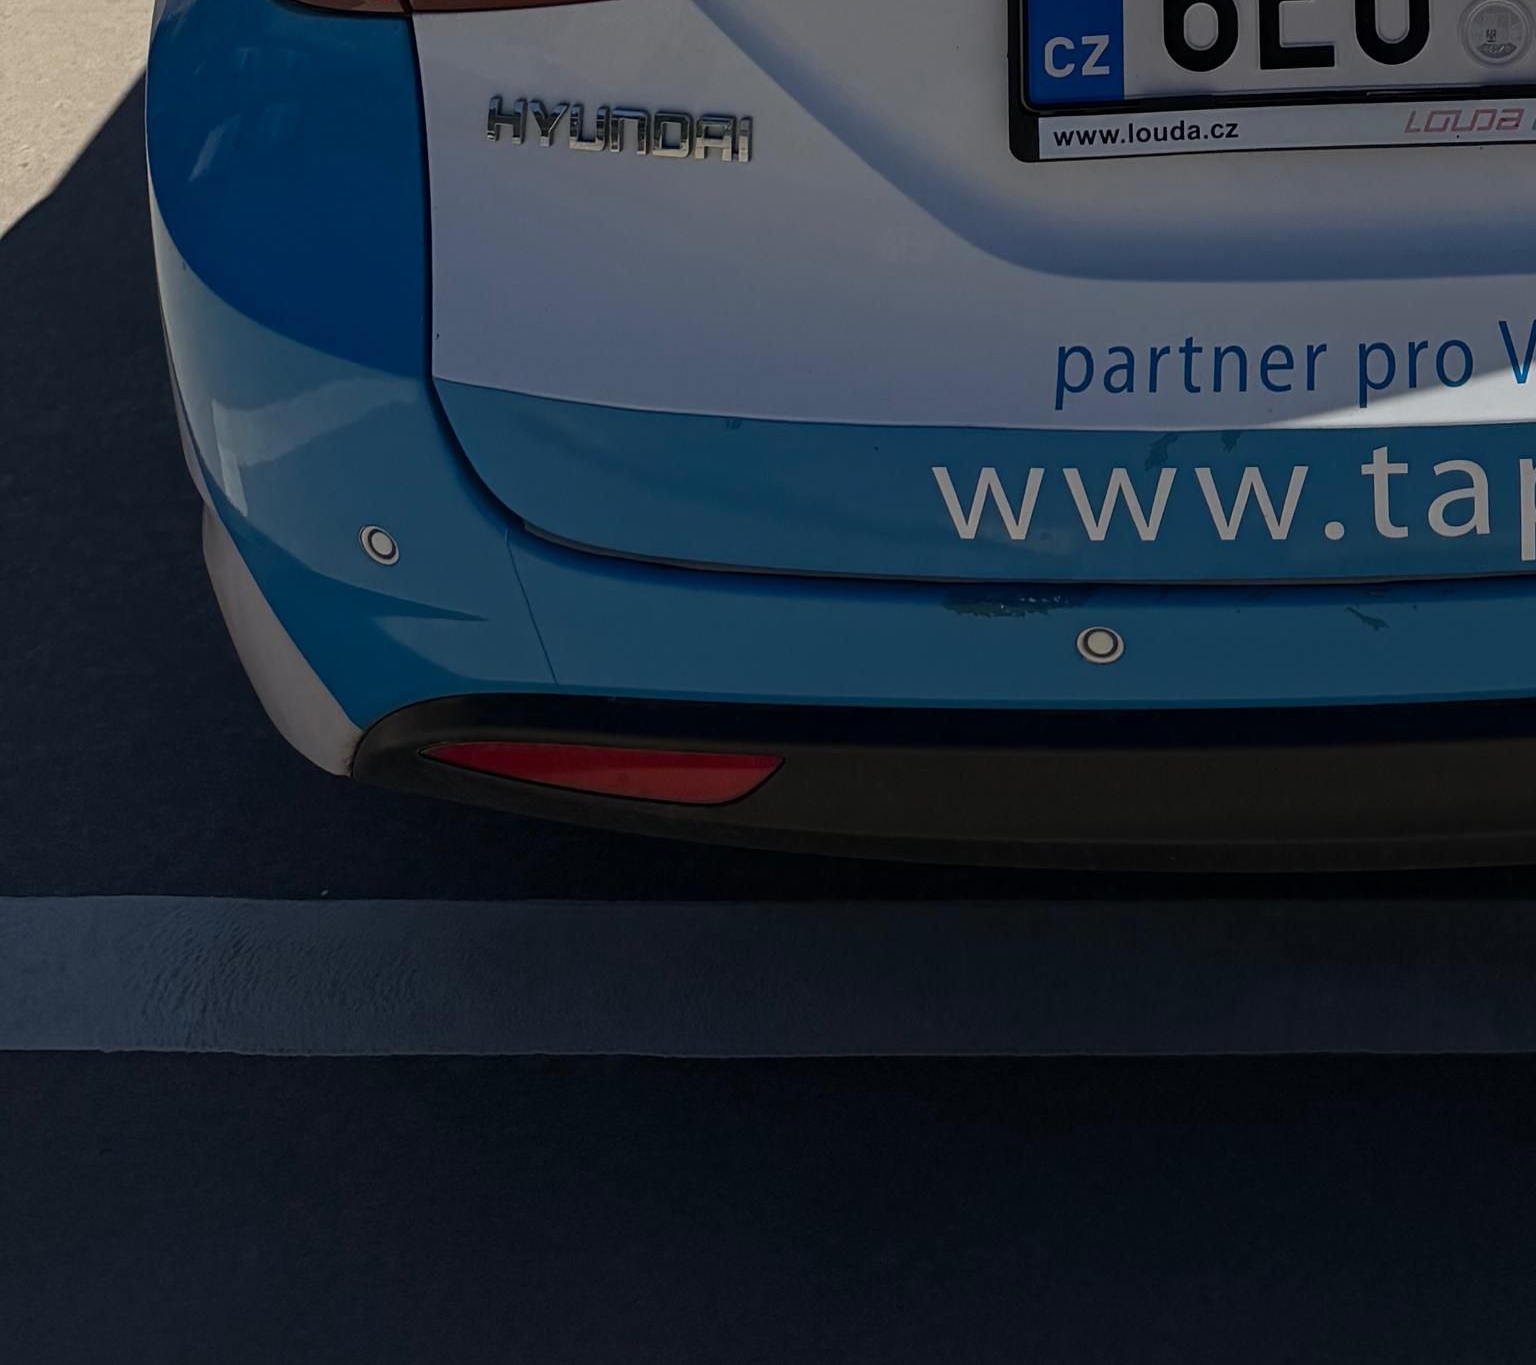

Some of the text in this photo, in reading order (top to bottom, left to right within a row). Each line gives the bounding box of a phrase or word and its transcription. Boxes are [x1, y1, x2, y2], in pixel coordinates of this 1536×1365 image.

[1043, 34, 1111, 78] CZ
[487, 95, 753, 163] HYUNDAI
[1053, 119, 1240, 148] www.louda.cz
[1403, 107, 1526, 134] LOUDA
[1054, 335, 1328, 411] partner
[1356, 336, 1475, 409] pro
